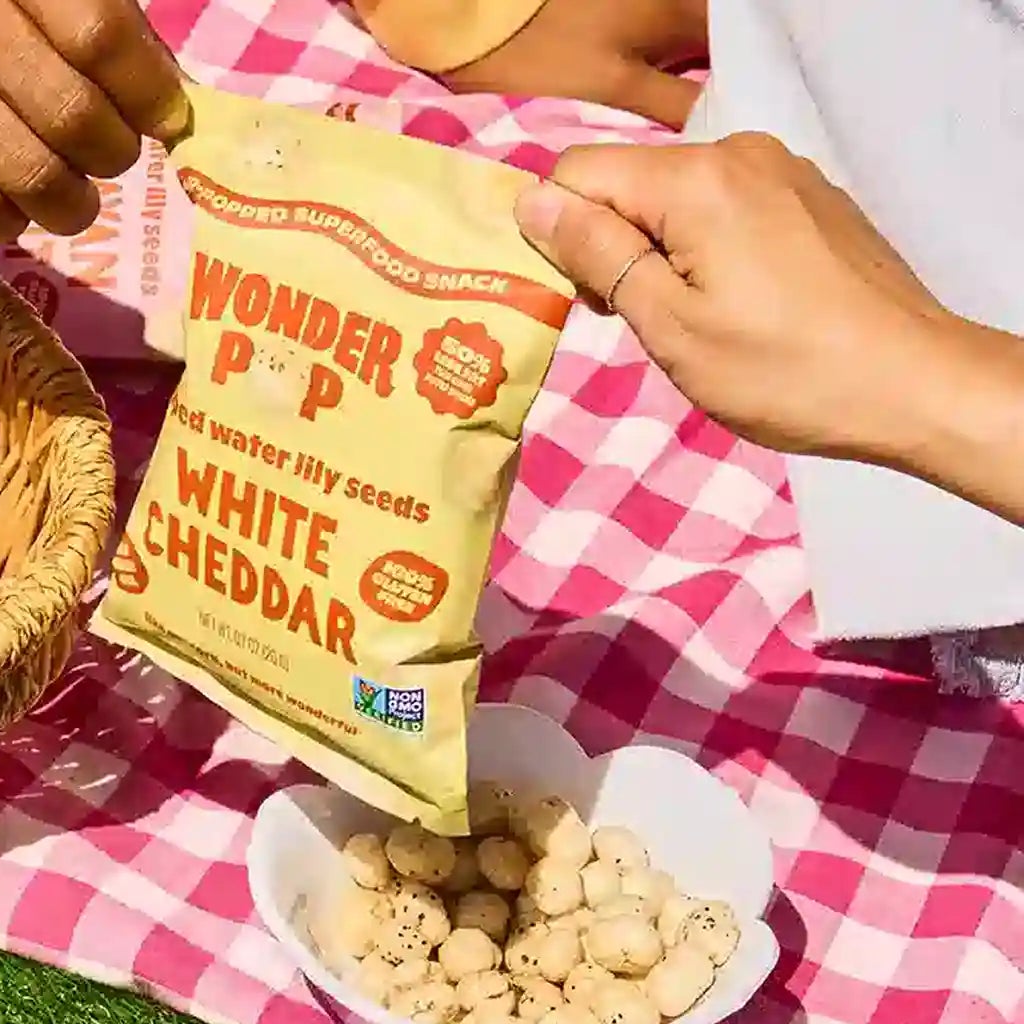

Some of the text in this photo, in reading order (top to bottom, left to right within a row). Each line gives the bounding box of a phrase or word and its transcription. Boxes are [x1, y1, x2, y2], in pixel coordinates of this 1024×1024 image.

[140, 224, 162, 297] seeds
[293, 205, 420, 283] SUPERFOOD
[422, 271, 509, 294] SNACK
[190, 251, 403, 399] WONDER
[176, 445, 339, 579] WHITE
[209, 418, 292, 471] water
[293, 451, 342, 495] lily
[343, 475, 431, 526] seeds
[143, 500, 358, 666] CHEDDAR
[388, 691, 422, 702] NON
[388, 700, 422, 712] GMO
